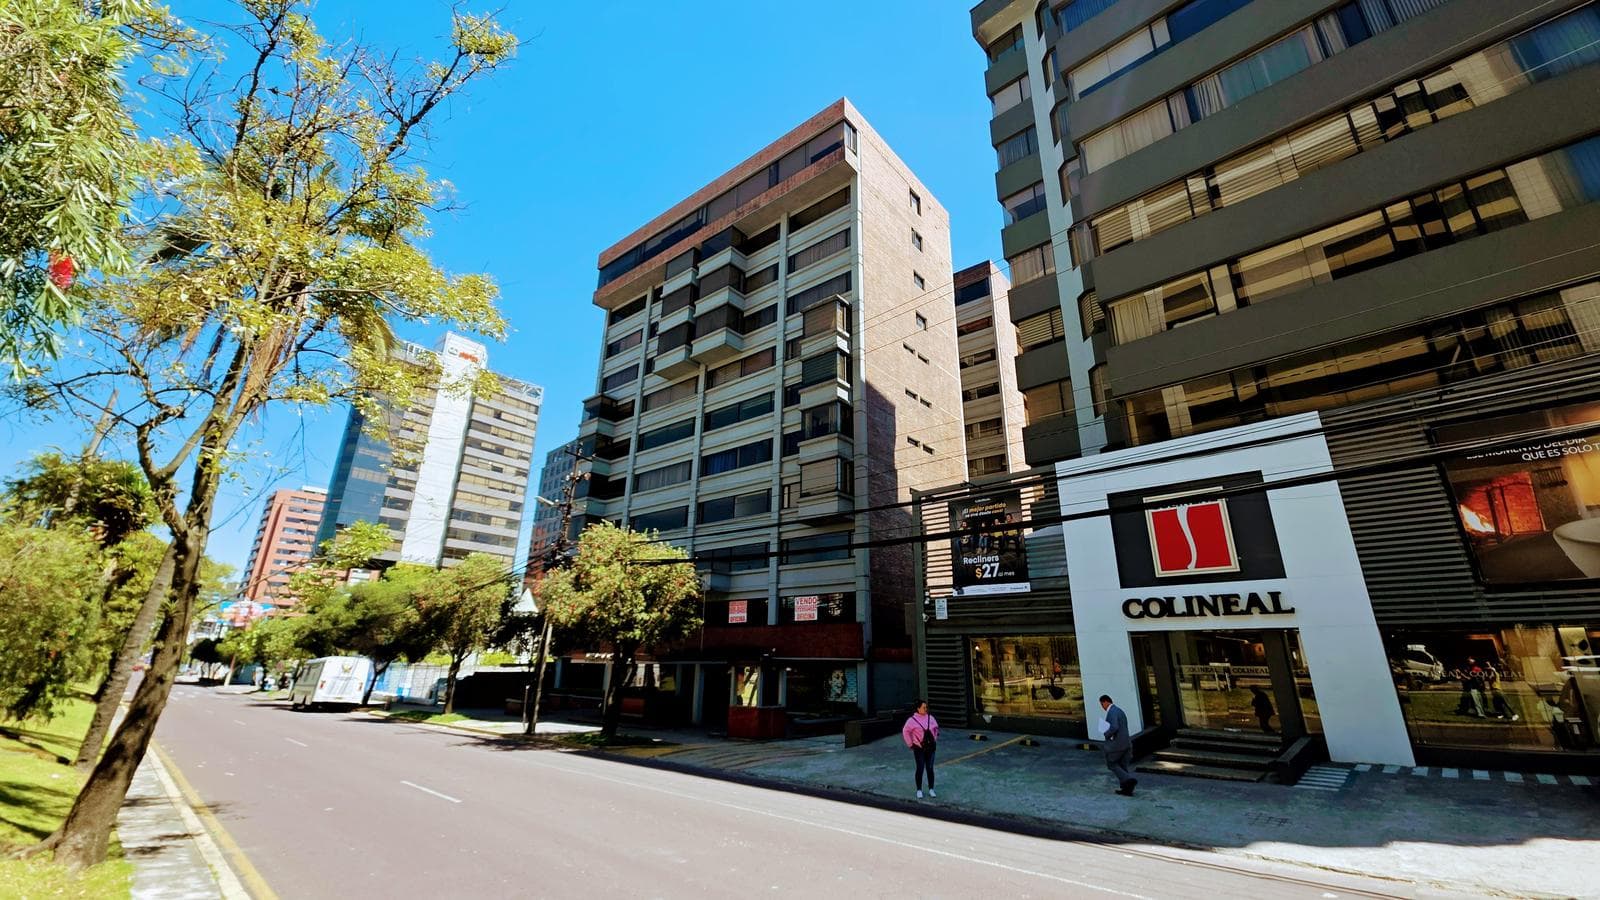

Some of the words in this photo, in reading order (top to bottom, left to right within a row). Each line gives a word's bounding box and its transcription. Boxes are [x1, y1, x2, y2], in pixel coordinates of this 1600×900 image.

[1521, 450, 1546, 461] QUE
[1547, 448, 1561, 457] ES
[1562, 444, 1592, 455] SOLO
[963, 555, 999, 565] Recliners
[1122, 591, 1295, 619] COLINEAL
[1232, 666, 1269, 674] COLINEAL
